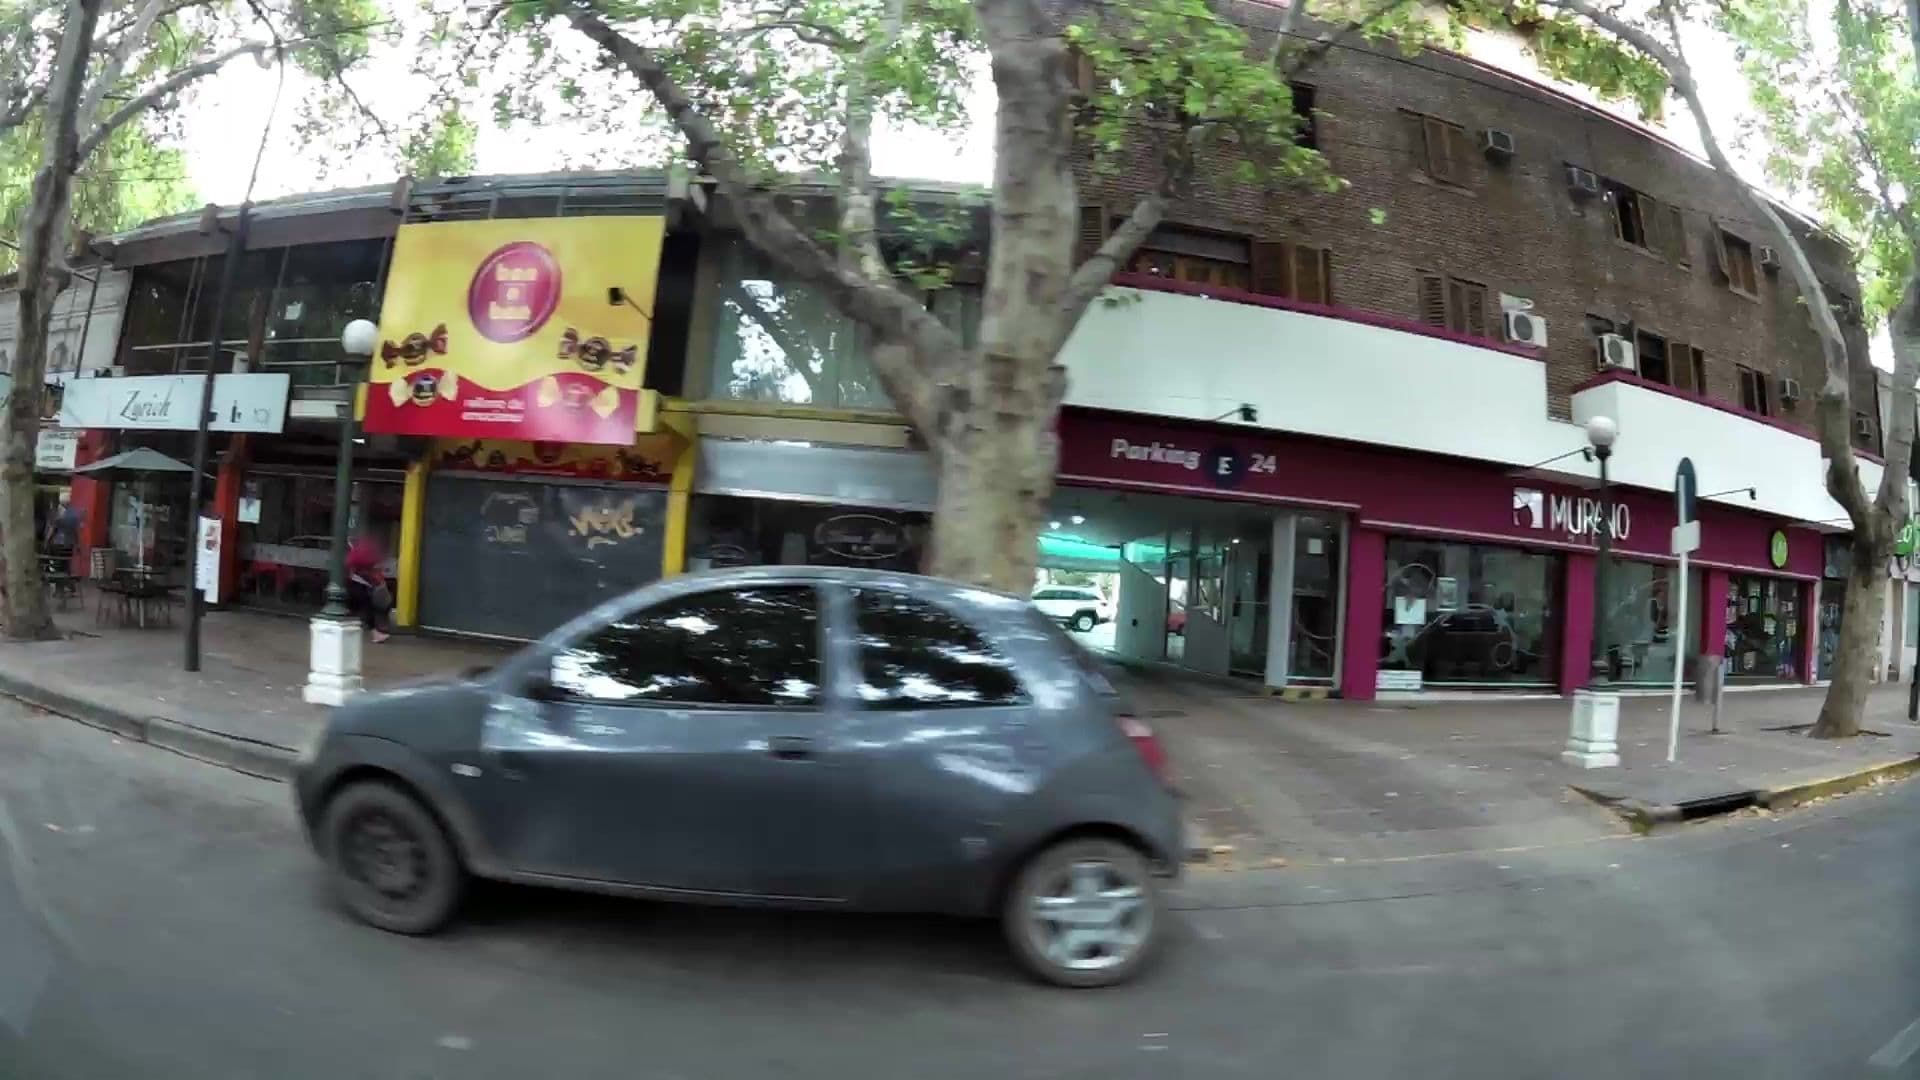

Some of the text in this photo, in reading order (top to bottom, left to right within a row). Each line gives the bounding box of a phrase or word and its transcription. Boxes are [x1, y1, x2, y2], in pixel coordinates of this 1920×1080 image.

[1110, 438, 1277, 475] Parking E 24
